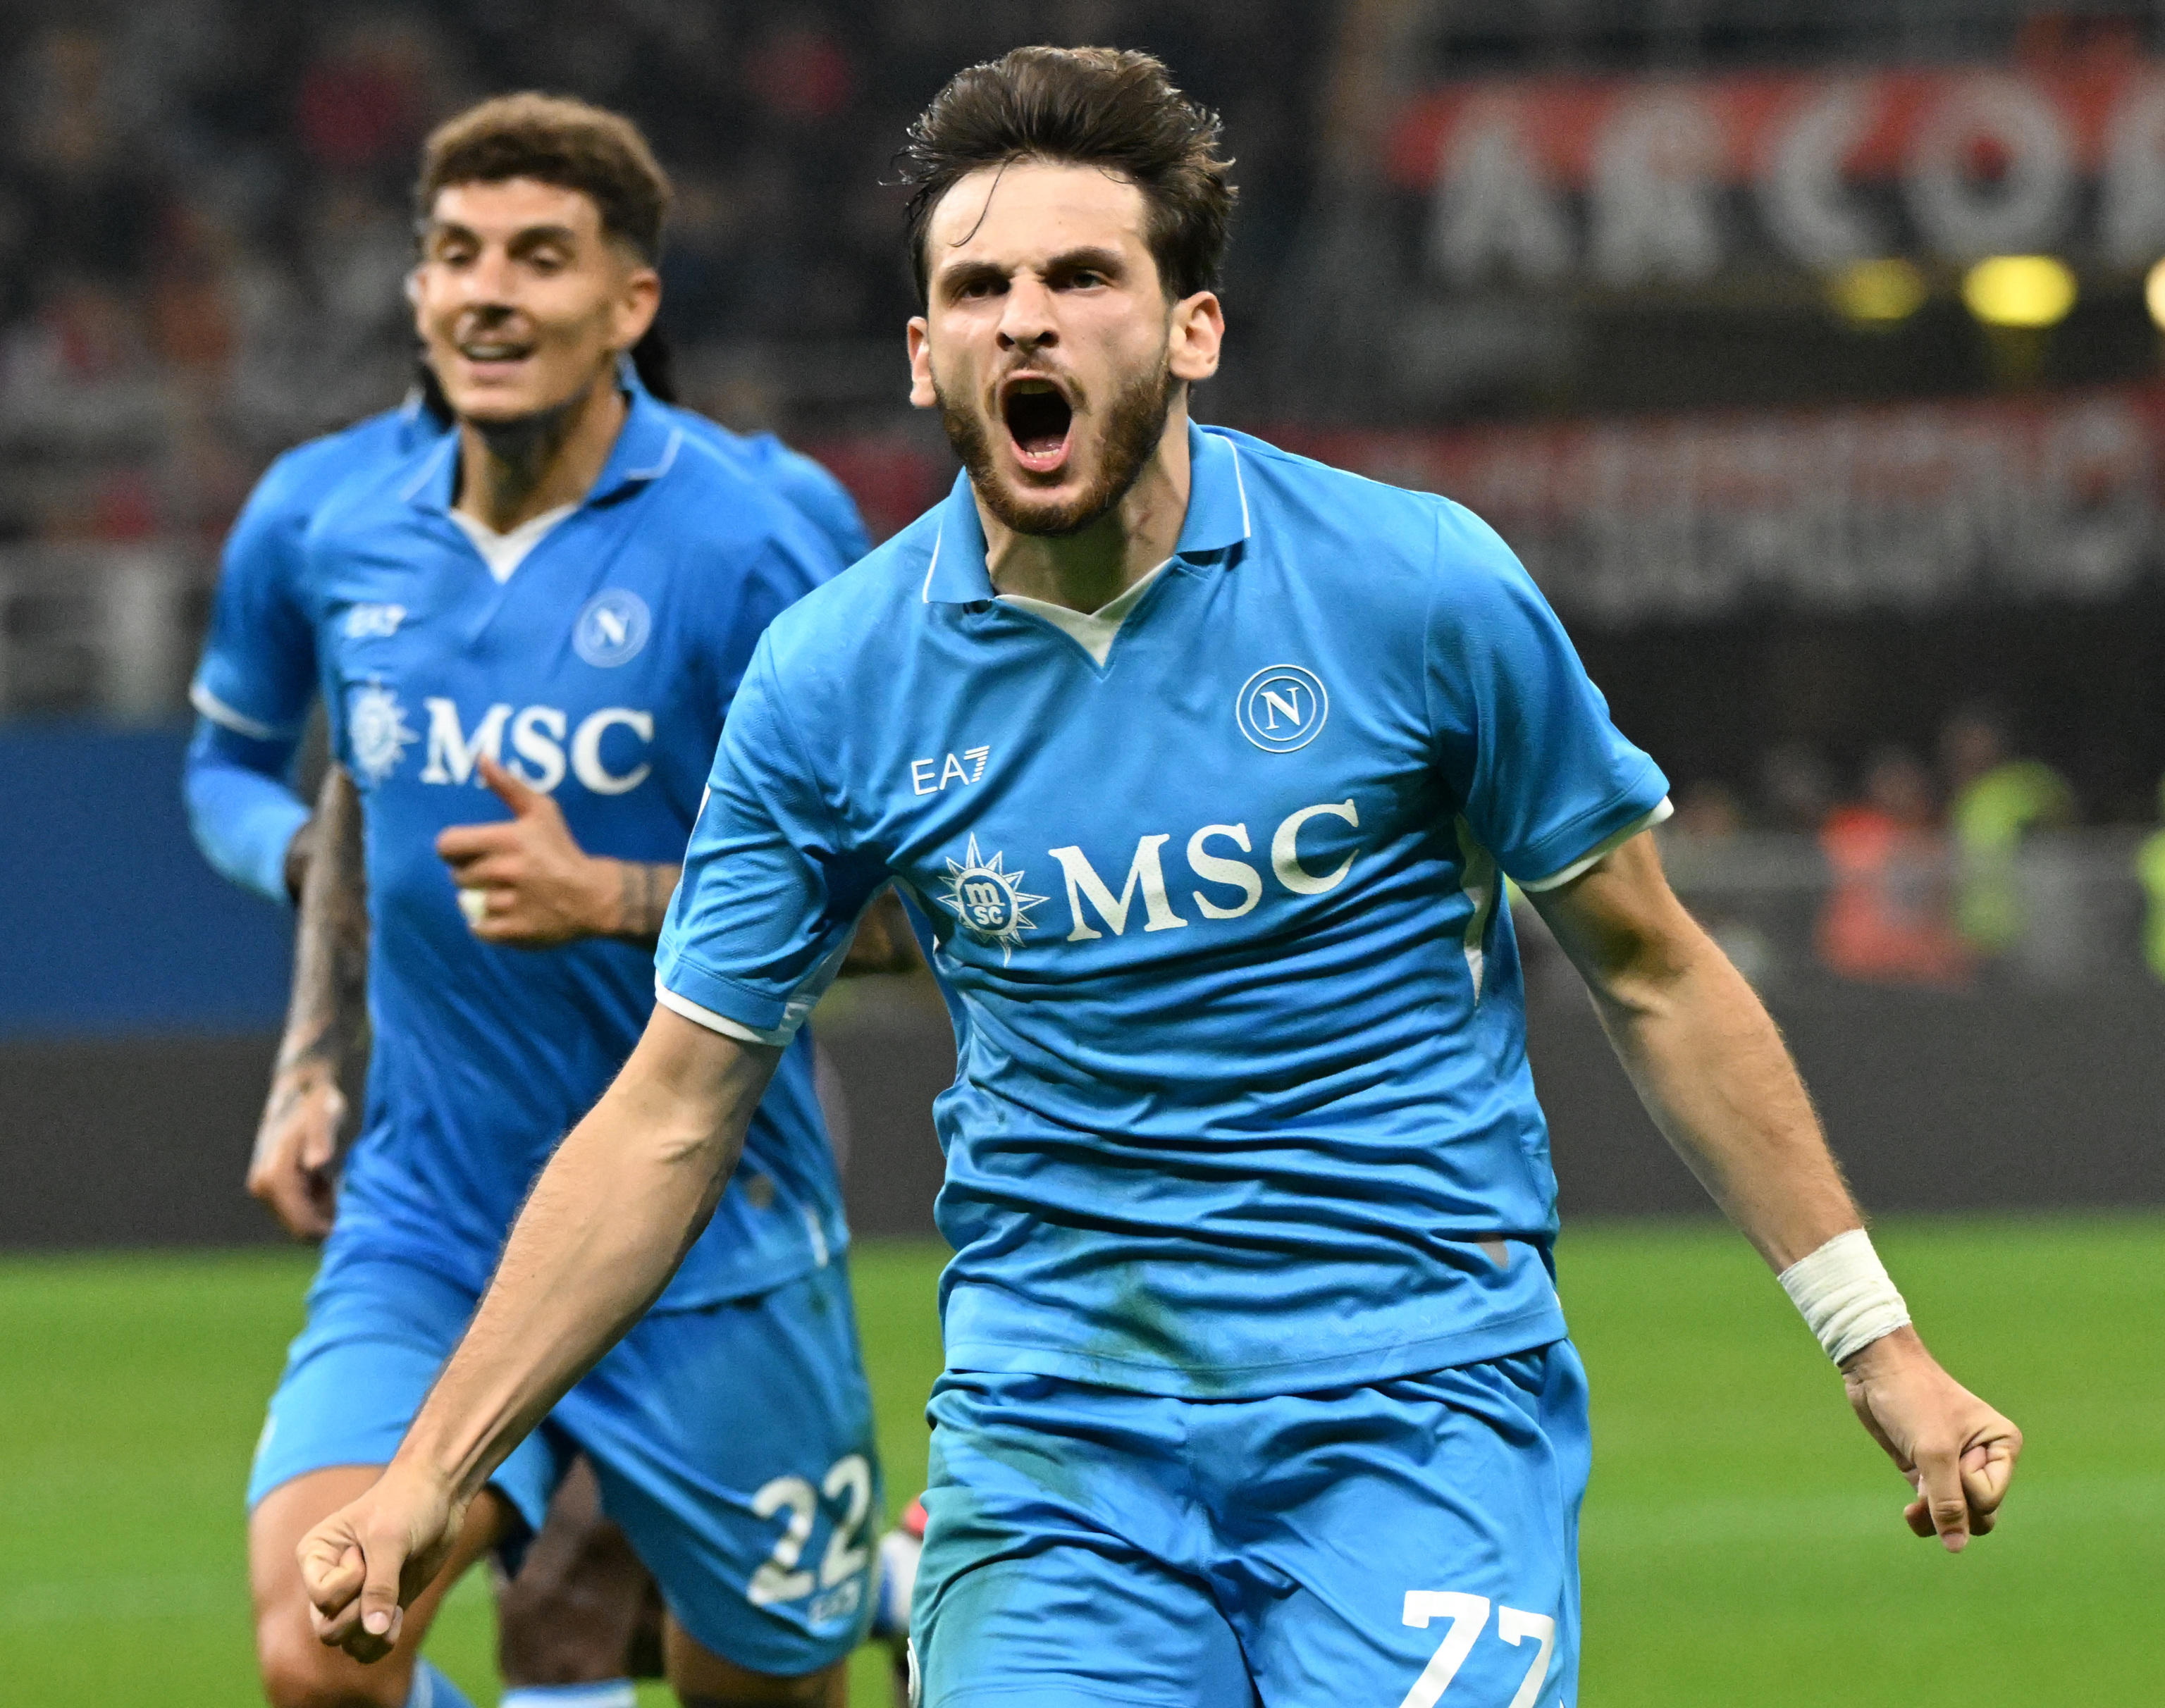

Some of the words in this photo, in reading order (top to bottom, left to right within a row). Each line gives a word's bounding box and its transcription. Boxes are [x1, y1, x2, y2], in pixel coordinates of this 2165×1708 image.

[594, 607, 630, 646] N
[419, 696, 654, 796] MSC
[1261, 687, 1300, 731] N
[911, 745, 990, 796] EA7
[1048, 798, 1359, 942] MSC
[746, 1454, 871, 1607] 22
[1402, 1590, 1555, 1708] 77
